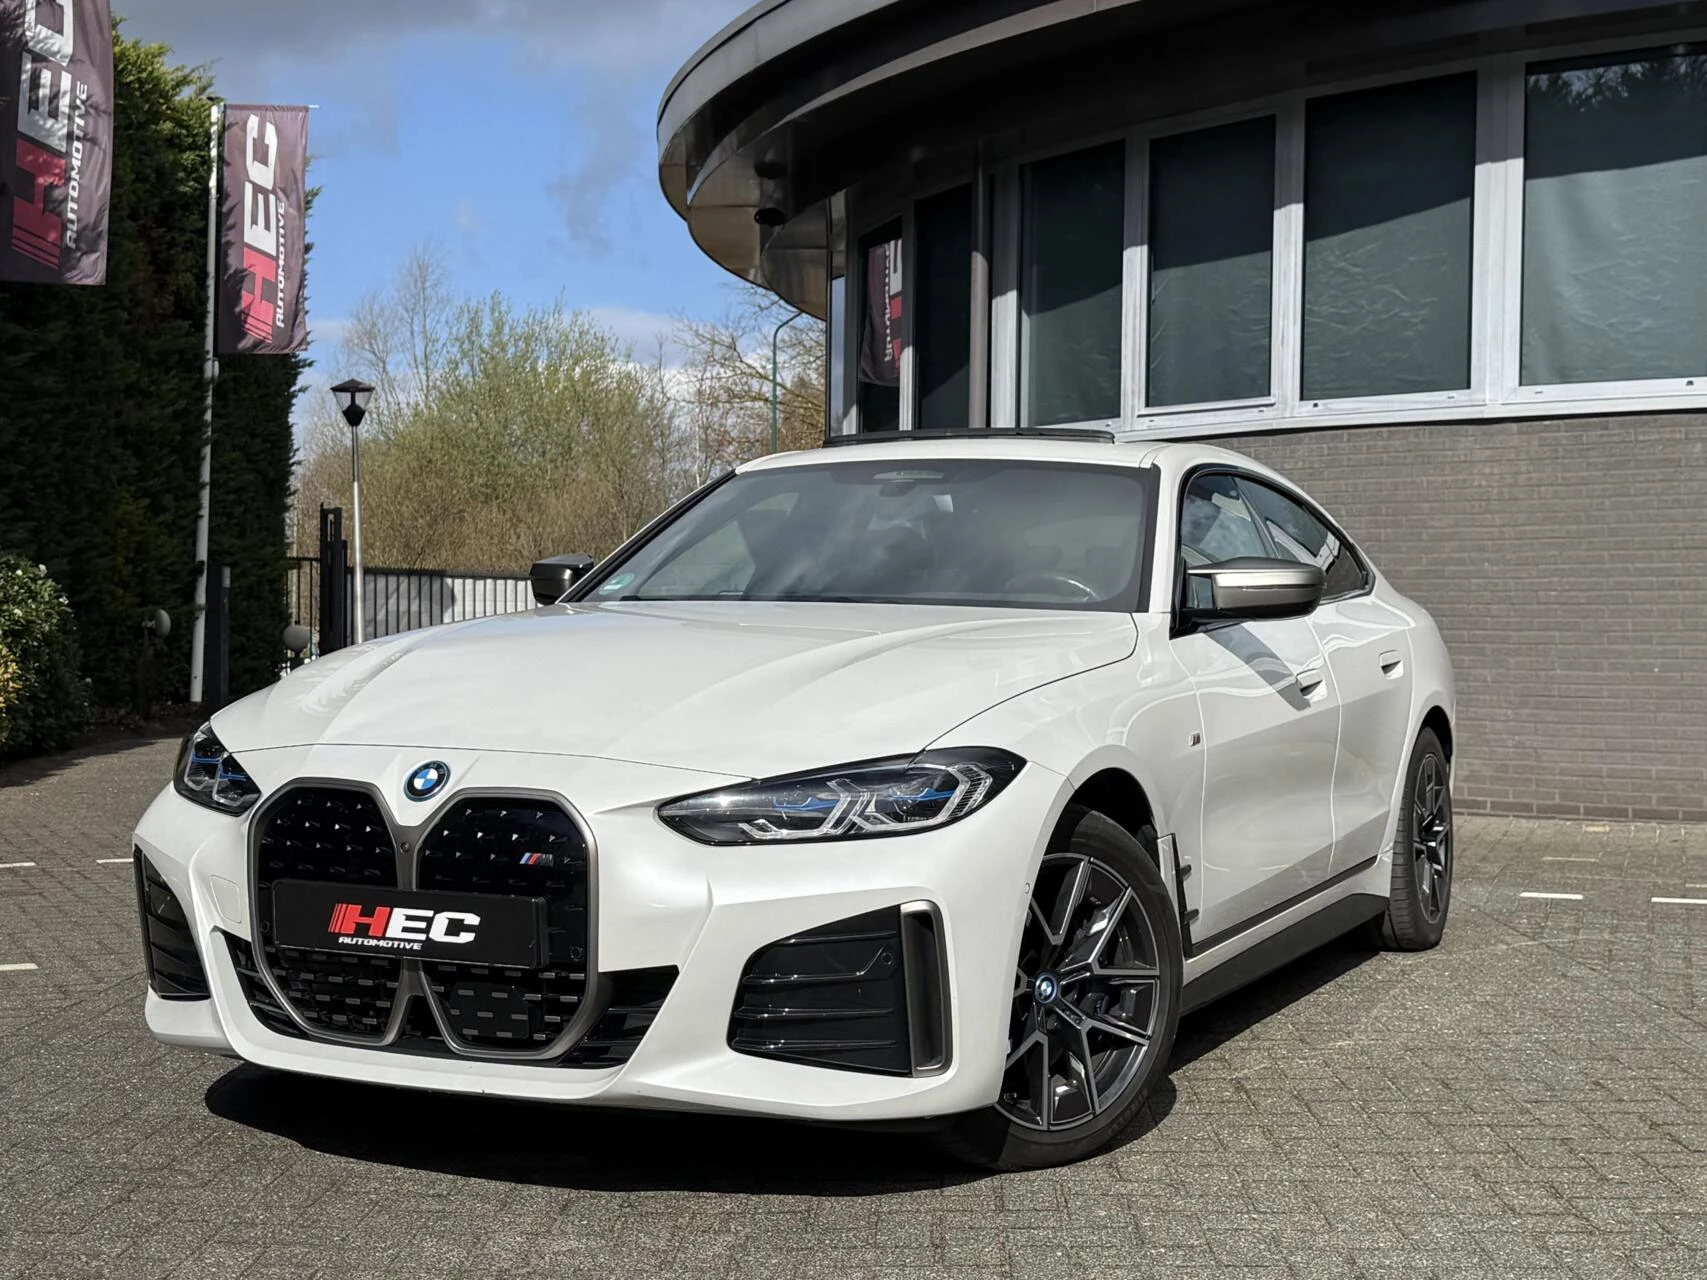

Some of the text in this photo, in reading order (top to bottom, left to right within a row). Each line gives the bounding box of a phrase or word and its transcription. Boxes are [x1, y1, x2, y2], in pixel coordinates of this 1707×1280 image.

[66, 80, 88, 249] AUTOMOTIVE
[241, 114, 278, 344] HEC
[276, 201, 286, 329] AUTOMOTIVE
[328, 903, 481, 944] HEC
[338, 936, 422, 950] AUTOMOTIVE
